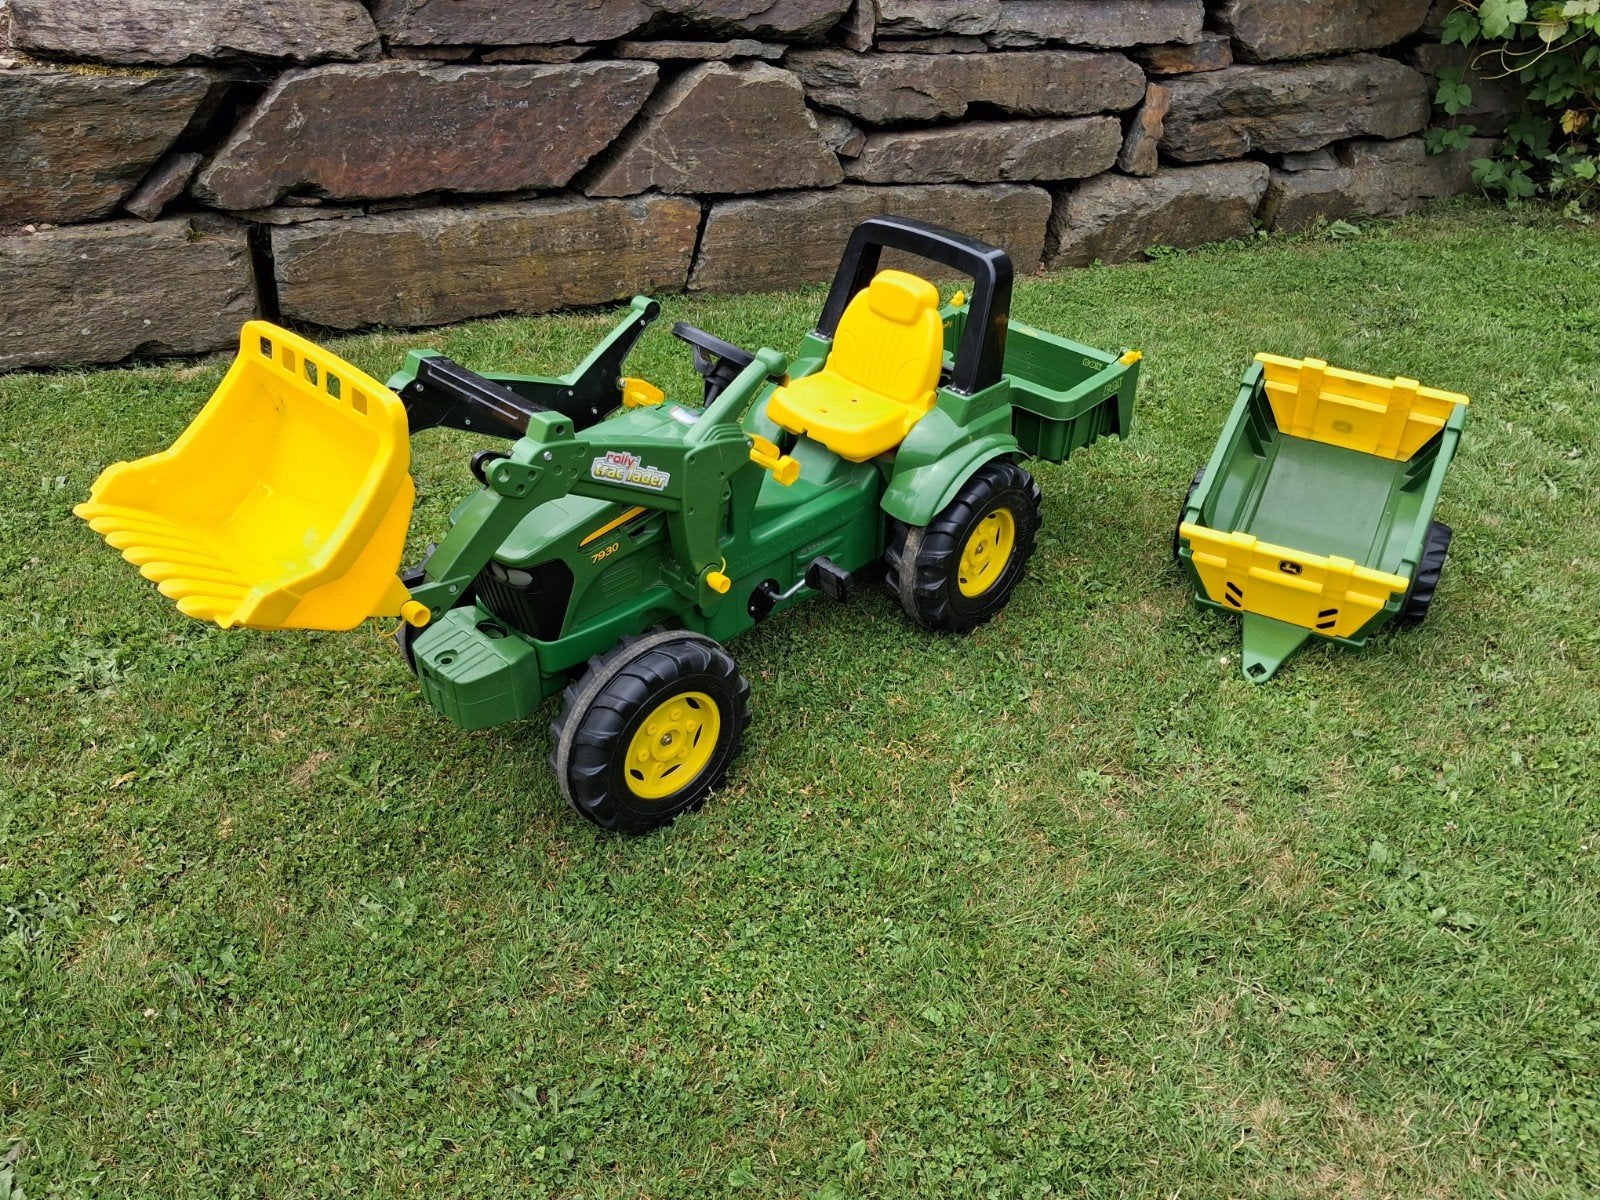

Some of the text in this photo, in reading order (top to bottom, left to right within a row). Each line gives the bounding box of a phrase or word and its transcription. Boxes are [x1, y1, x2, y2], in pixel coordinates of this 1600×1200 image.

[607, 453, 636, 468] rolly
[595, 462, 667, 487] trac lader
[591, 542, 619, 564] 7930
